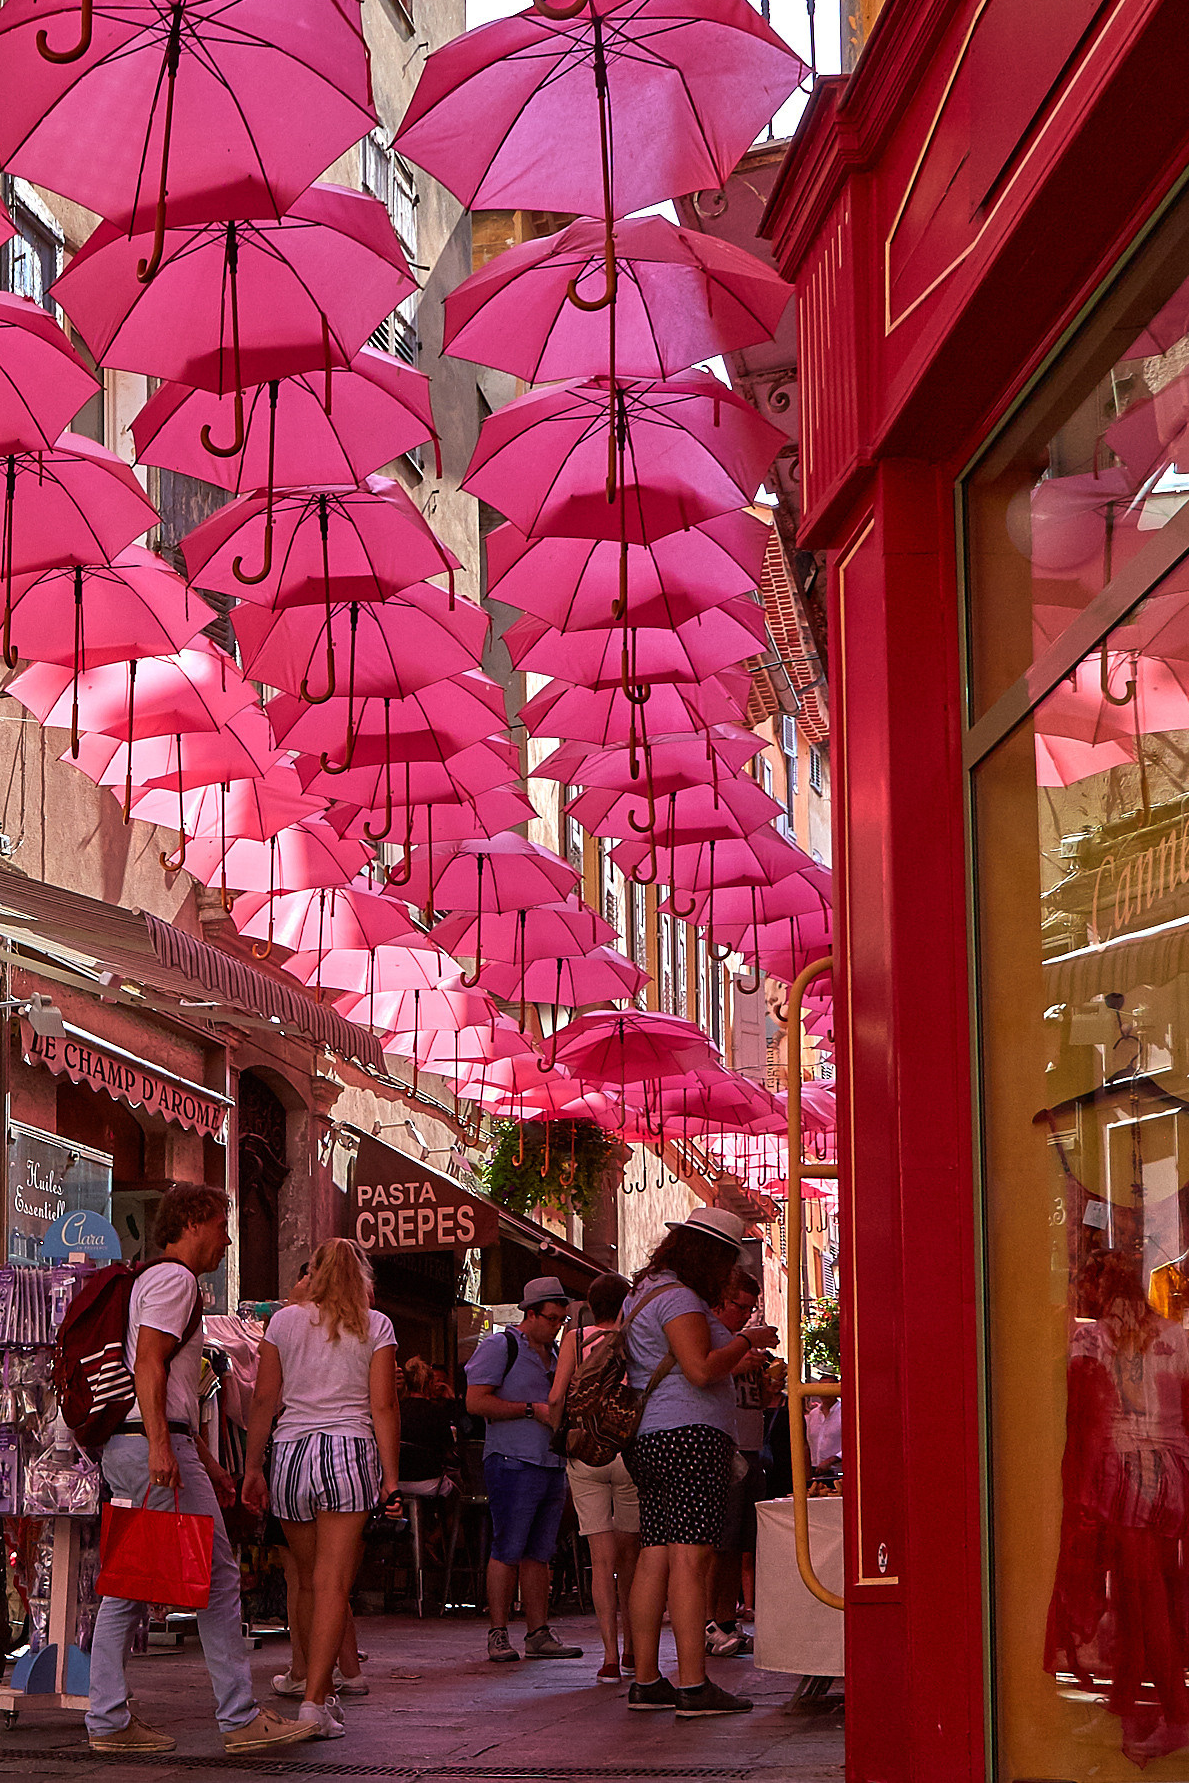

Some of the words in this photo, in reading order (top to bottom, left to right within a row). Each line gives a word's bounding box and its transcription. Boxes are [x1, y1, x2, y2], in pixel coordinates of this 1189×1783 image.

[766, 1037, 780, 1088] ragonard
[30, 1035, 57, 1061] LE
[64, 1043, 136, 1093] CHAMP
[142, 1076, 221, 1130] D'AROME
[26, 1160, 64, 1195] Huiles
[357, 1181, 437, 1207] PASTA
[14, 1184, 66, 1222] Essentiell
[61, 1212, 105, 1247] Clara
[356, 1205, 475, 1249] CREPES
